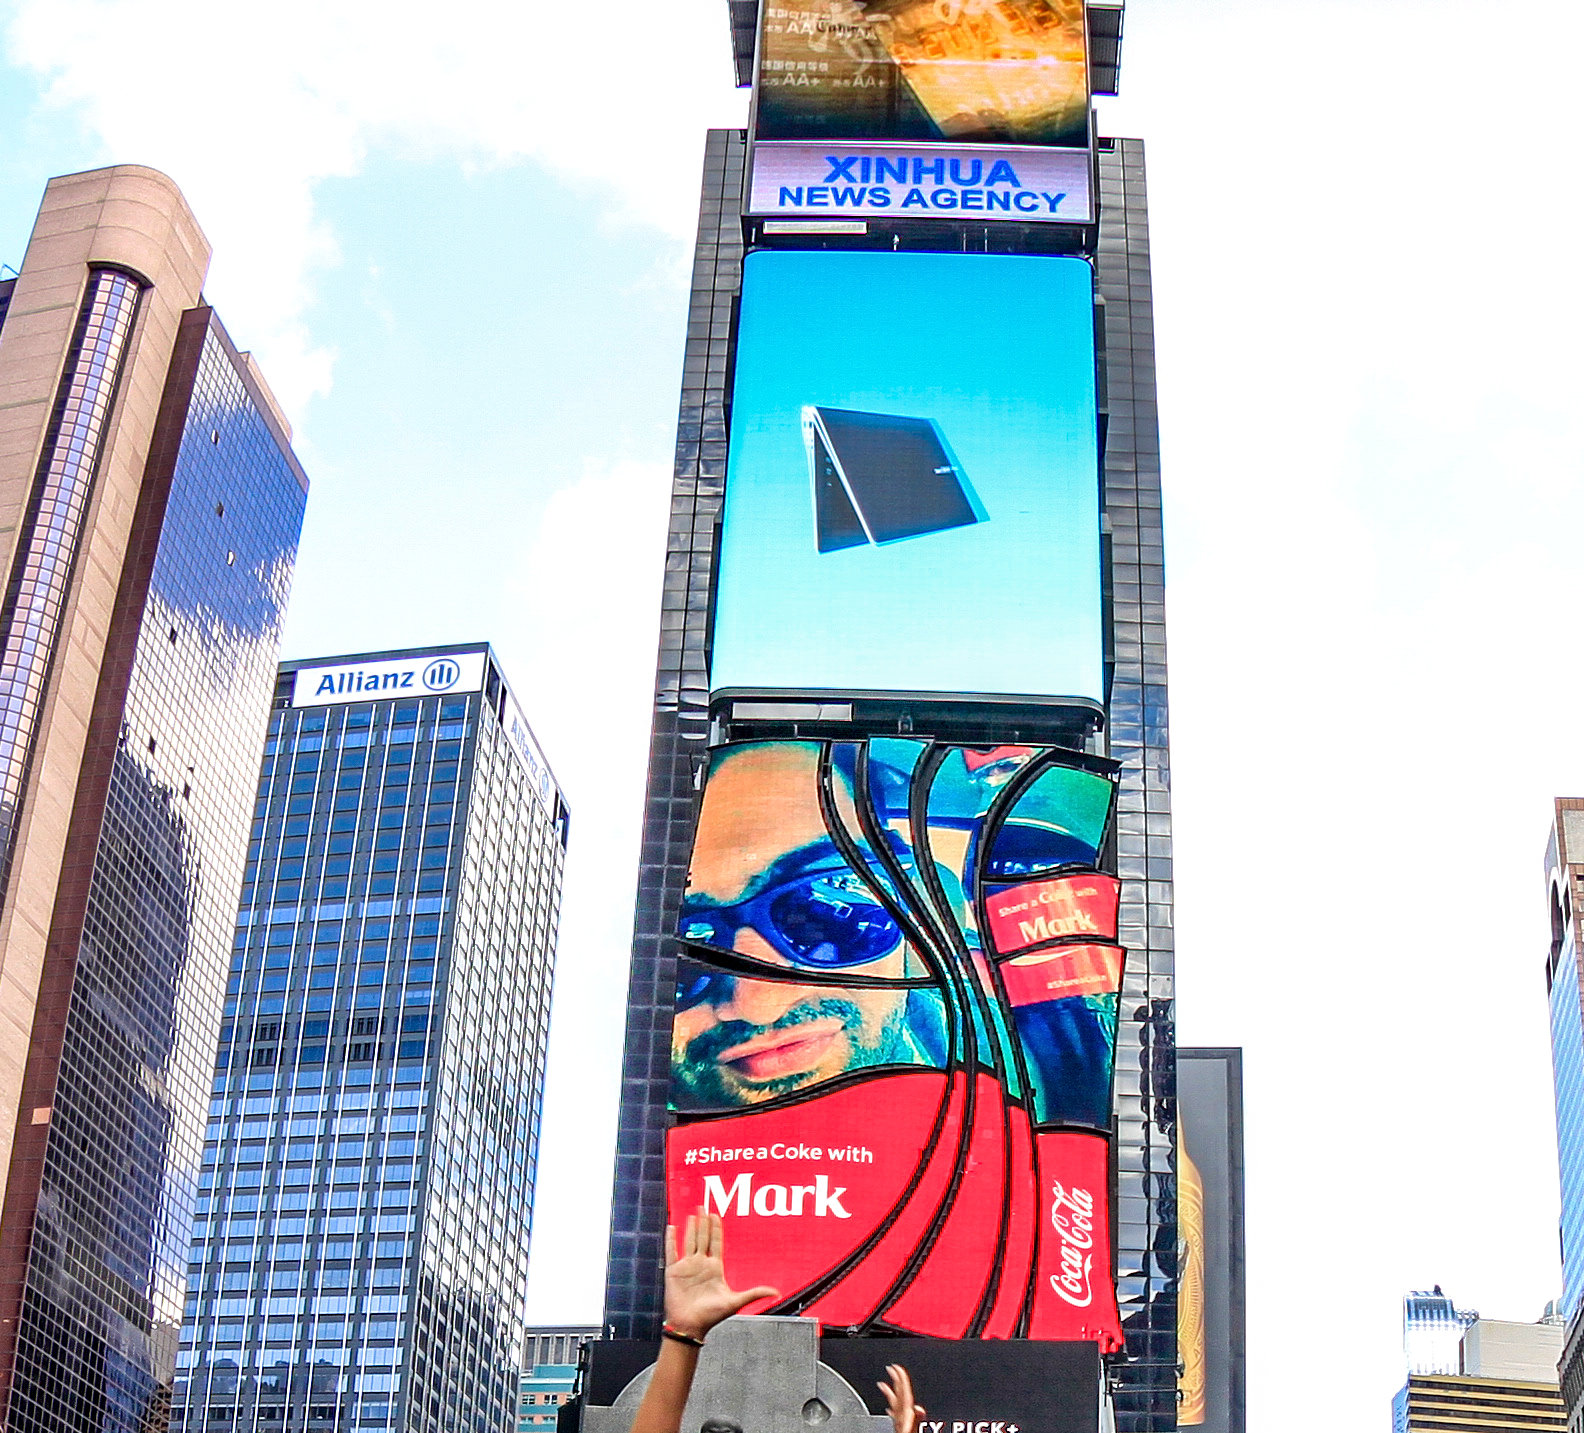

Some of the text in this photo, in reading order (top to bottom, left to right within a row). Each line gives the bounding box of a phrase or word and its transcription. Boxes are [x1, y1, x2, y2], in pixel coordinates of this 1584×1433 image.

[824, 156, 1022, 188] XINHUA
[778, 186, 1067, 214] NEWS AGENCY
[315, 670, 415, 697] Allianz
[999, 901, 1029, 917] Share
[1018, 909, 1098, 943] Mark
[827, 1145, 874, 1166] with
[703, 1174, 853, 1219] Mark
[1049, 1181, 1096, 1308] Coca-Cola
